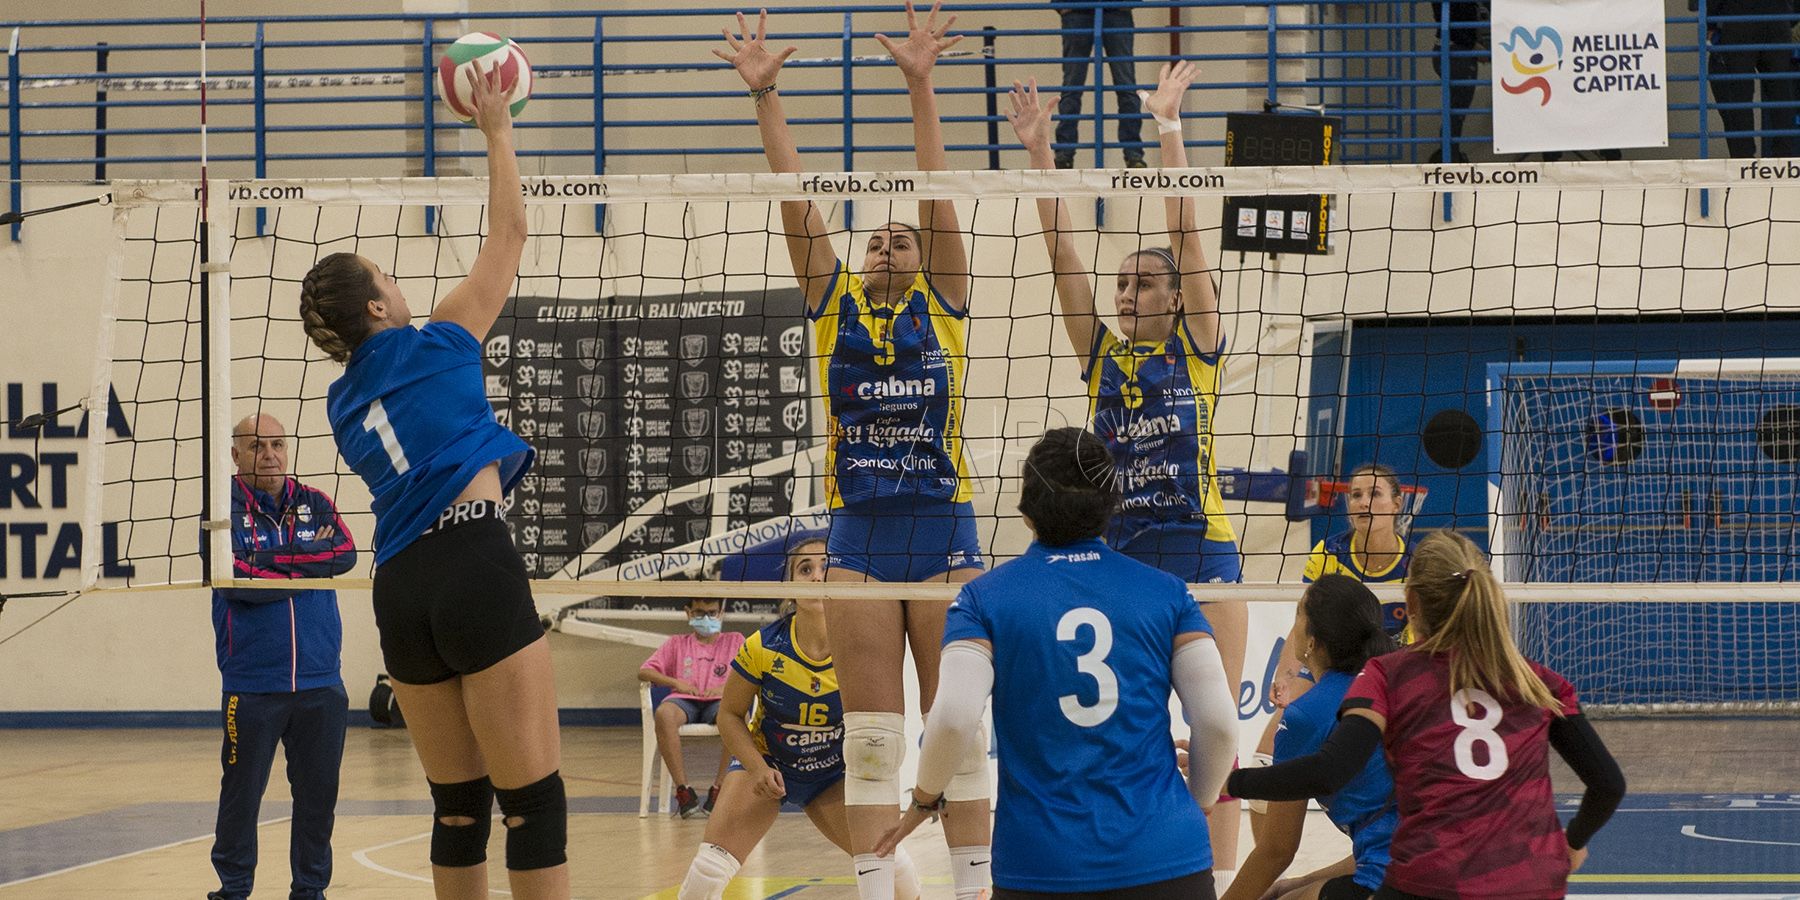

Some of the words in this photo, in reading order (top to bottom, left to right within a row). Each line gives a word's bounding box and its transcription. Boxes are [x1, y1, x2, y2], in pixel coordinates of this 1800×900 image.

[1572, 33, 1659, 53] MELILLA
[1573, 54, 1644, 73] SPORT
[1573, 74, 1661, 93] CAPITAL
[1111, 171, 1224, 188] rfevb.com
[1424, 167, 1538, 184] rfevb.com
[1740, 160, 1800, 179] rfevb
[521, 179, 608, 196] evb.com
[802, 175, 915, 192] rfevb.com
[537, 306, 578, 323] CLUB
[649, 301, 745, 318] BALONCESTO
[857, 376, 935, 399] cabna
[1120, 374, 1143, 410] 6
[0, 383, 133, 439] LLA
[879, 402, 918, 412] Seguros
[362, 398, 410, 475] 1
[901, 455, 937, 470] Clinic
[1153, 491, 1187, 507] Clinic
[439, 500, 486, 530] PRO
[623, 554, 691, 582] CIUDAD
[698, 520, 806, 560] AUTÓNOMA
[1056, 607, 1119, 727] 3
[799, 703, 829, 726] 16
[1450, 687, 1510, 781] 8
